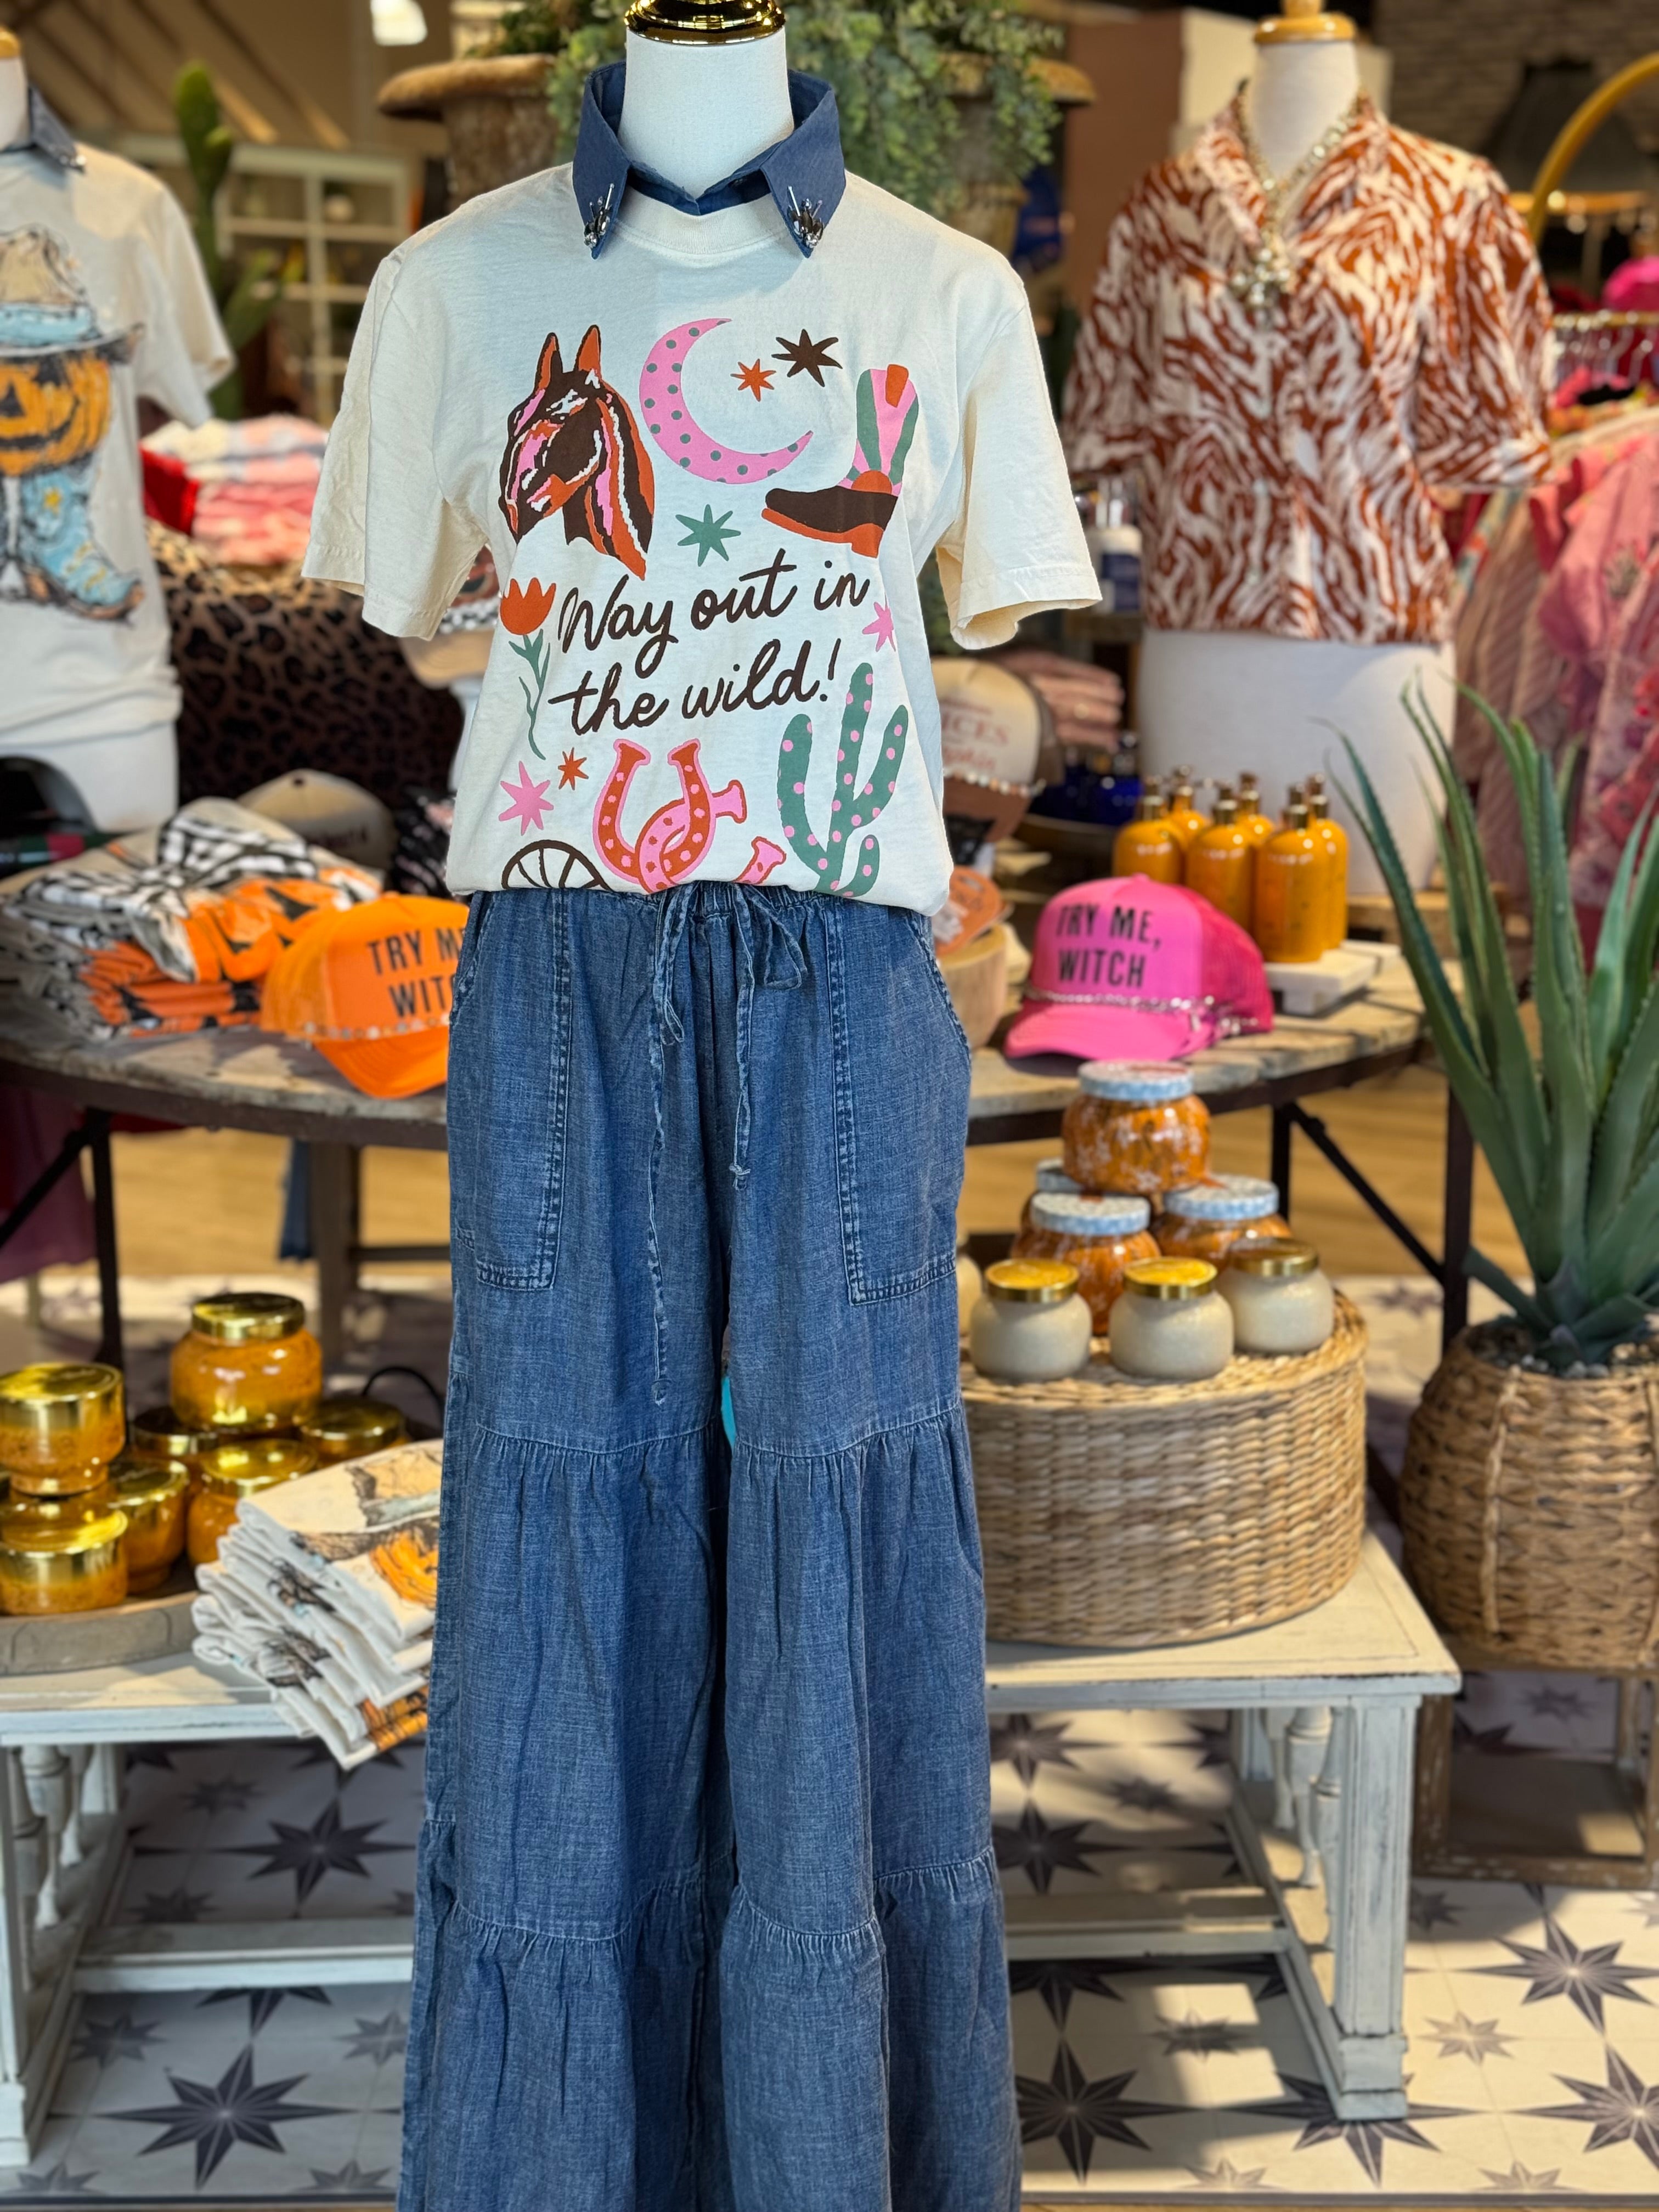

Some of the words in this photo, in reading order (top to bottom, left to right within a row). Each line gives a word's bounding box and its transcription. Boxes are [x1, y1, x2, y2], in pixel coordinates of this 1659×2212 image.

[558, 573, 679, 679] Way
[690, 548, 798, 630] out
[814, 560, 871, 611] in
[548, 662, 669, 736] the
[681, 638, 842, 720] wild!
[1056, 902, 1098, 935] TRY
[1109, 905, 1162, 951] ME,
[366, 929, 422, 976] TRY
[435, 928, 465, 961] M
[1057, 948, 1147, 988] WITCH
[388, 973, 456, 1018] WIT
